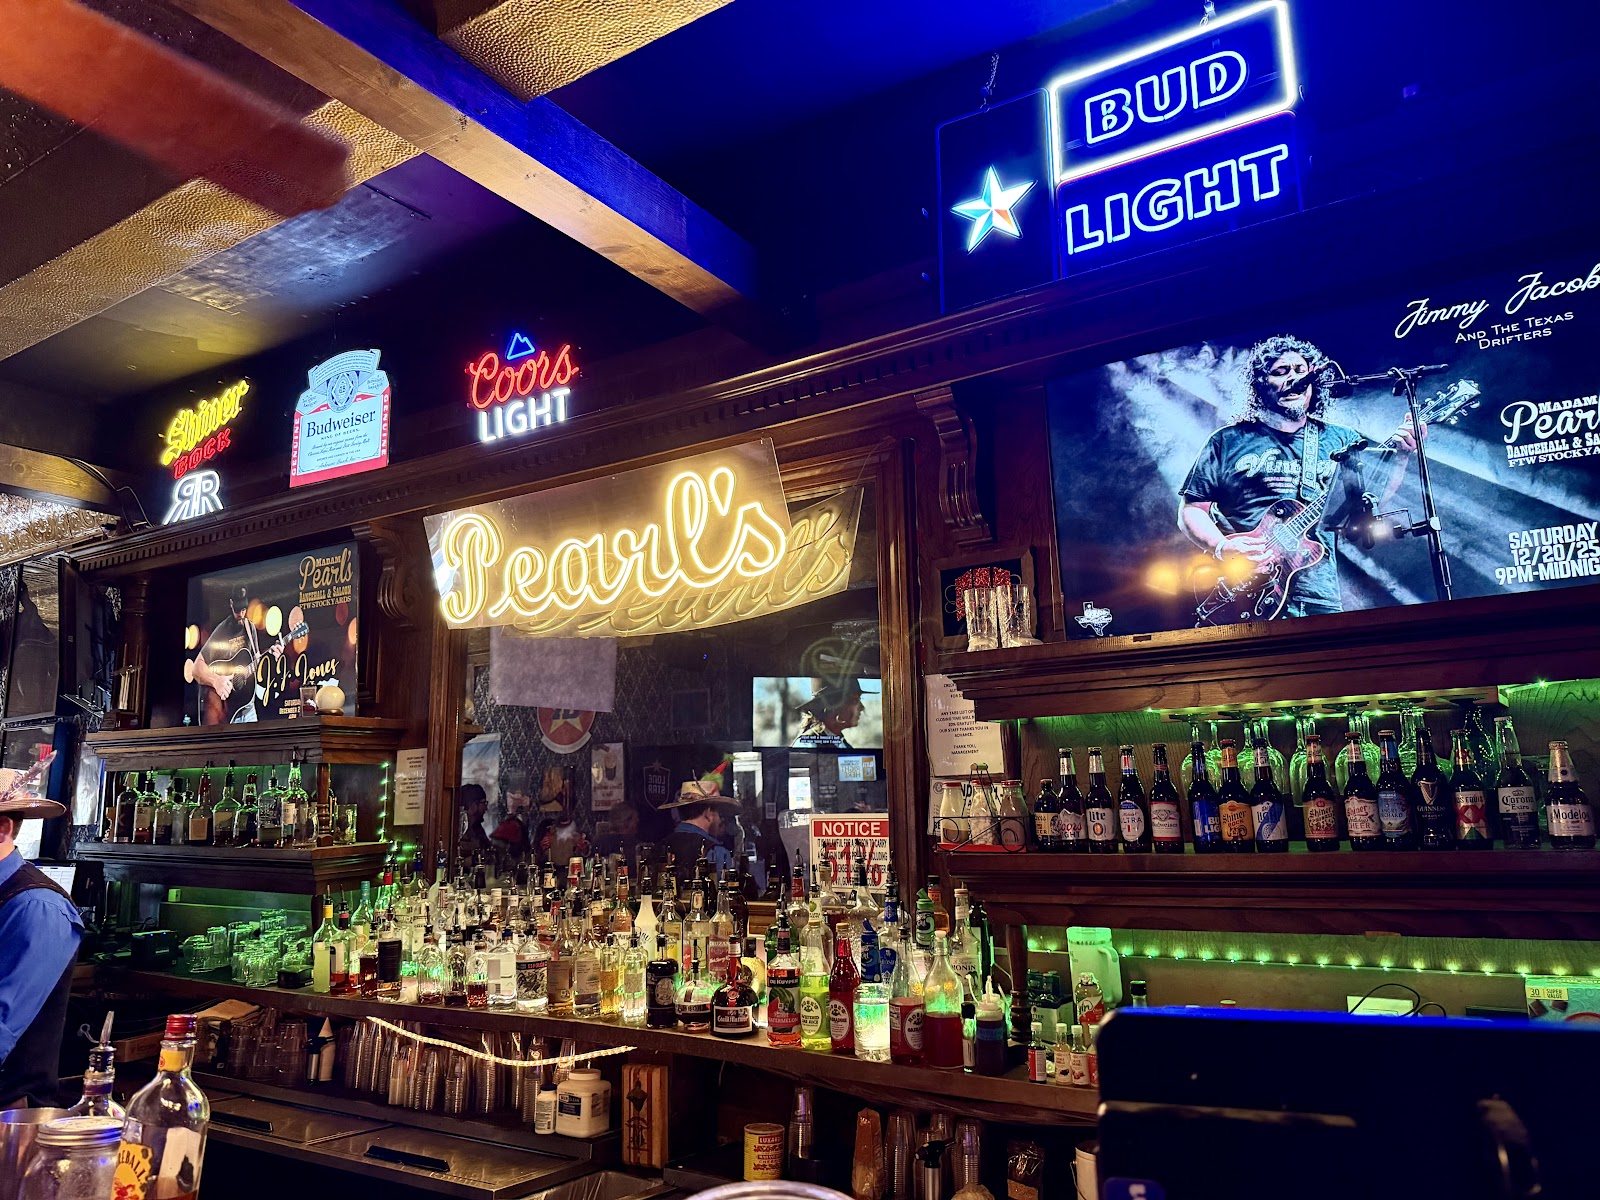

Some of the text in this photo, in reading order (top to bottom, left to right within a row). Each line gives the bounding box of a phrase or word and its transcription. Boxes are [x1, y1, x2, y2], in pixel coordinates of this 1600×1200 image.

[1084, 50, 1247, 145] BUD
[1066, 143, 1289, 255] LIGHT
[1394, 298, 1490, 339] Jimmy
[1455, 311, 1574, 344] AND THE TEXAS
[1478, 328, 1552, 350] DRIFTERS
[466, 344, 580, 410] Coors
[479, 387, 571, 443] LIGHT
[1538, 395, 1598, 415] MADAM
[160, 380, 250, 466] Shiner
[306, 410, 376, 438] Budweiser
[173, 427, 232, 480] BOCK
[1506, 438, 1569, 460] DANCEHALL
[1572, 436, 1583, 448] &
[1508, 455, 1537, 468] FTW
[438, 466, 788, 624] Pearl's
[1508, 521, 1598, 550] SATURDAY
[1511, 538, 1600, 567] 12/20/25
[298, 547, 353, 591] Pearl's
[311, 595, 352, 609] STOCKYARDS
[1501, 795, 1535, 806] Corona
[1088, 810, 1106, 823] Lite
[1207, 816, 1220, 825] BU
[1222, 811, 1247, 824] Shiner
[1553, 808, 1589, 821] Modelo
[821, 821, 881, 836] NOTICE
[1062, 831, 1081, 839] IGHT
[1204, 824, 1220, 833] LIG
[1530, 988, 1540, 996] 30
